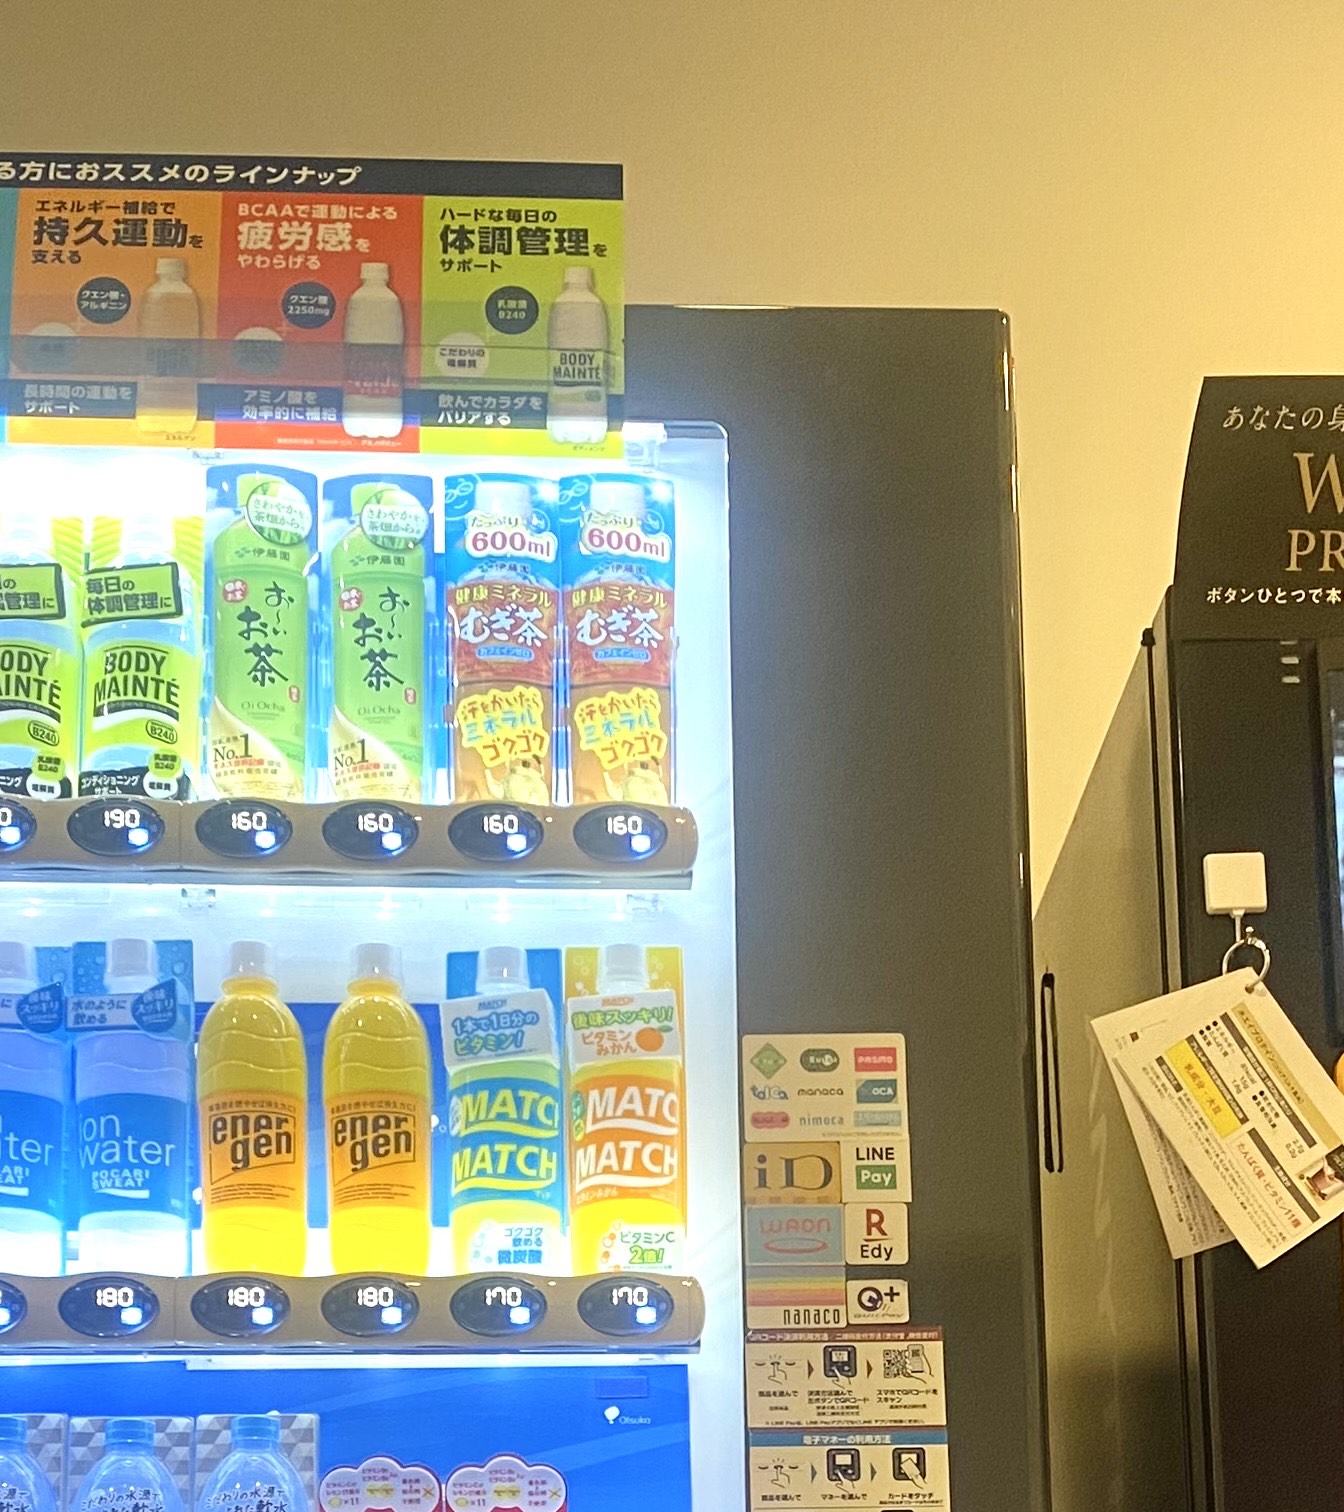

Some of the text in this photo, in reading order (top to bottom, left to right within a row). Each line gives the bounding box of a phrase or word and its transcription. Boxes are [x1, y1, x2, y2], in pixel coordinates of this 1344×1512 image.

[36, 199, 175, 215] エネルギー補給で
[238, 204, 397, 220] BCAAで運動による
[440, 208, 556, 223] ハードな毎日の
[33, 217, 203, 249] 持久運動を
[237, 223, 369, 252] 疲労感を
[440, 226, 607, 257] 体調管理を
[31, 250, 82, 264] 支える
[237, 254, 321, 270] やわらげる
[440, 259, 502, 273] サポート
[24, 385, 132, 399] 長時間の運動を
[242, 406, 336, 421] 効率的に補給
[472, 529, 552, 558] 600ml
[587, 528, 666, 558] 600ml
[87, 576, 134, 594] 毎日の
[572, 585, 667, 607] 健康ミネラル
[459, 607, 548, 647] むぎ茶
[577, 608, 663, 648] むぎ茶
[32, 728, 56, 744] B240
[214, 733, 252, 762] No.1
[104, 809, 140, 828] 190
[231, 812, 267, 831] 160
[483, 815, 519, 833] 160
[607, 816, 642, 835] 160
[452, 1011, 539, 1033] 1本で1日分の
[582, 1028, 632, 1043] ビタミン
[797, 1088, 844, 1096] manaca
[80, 1113, 120, 1138] ion
[800, 1115, 844, 1125] nimoca
[80, 1135, 175, 1168] water
[856, 1147, 894, 1161] LINE
[453, 1144, 557, 1182] MATCH
[754, 1154, 833, 1190] iD
[861, 1169, 893, 1187] Pay
[620, 1231, 675, 1244] ビタミンC
[860, 1244, 893, 1260] Edy
[97, 1287, 134, 1307] 180
[485, 1287, 522, 1306] 170
[612, 1287, 648, 1306] 170
[784, 1308, 840, 1325] nanaco
[803, 1435, 891, 1444] 電子マネーの利用方法
